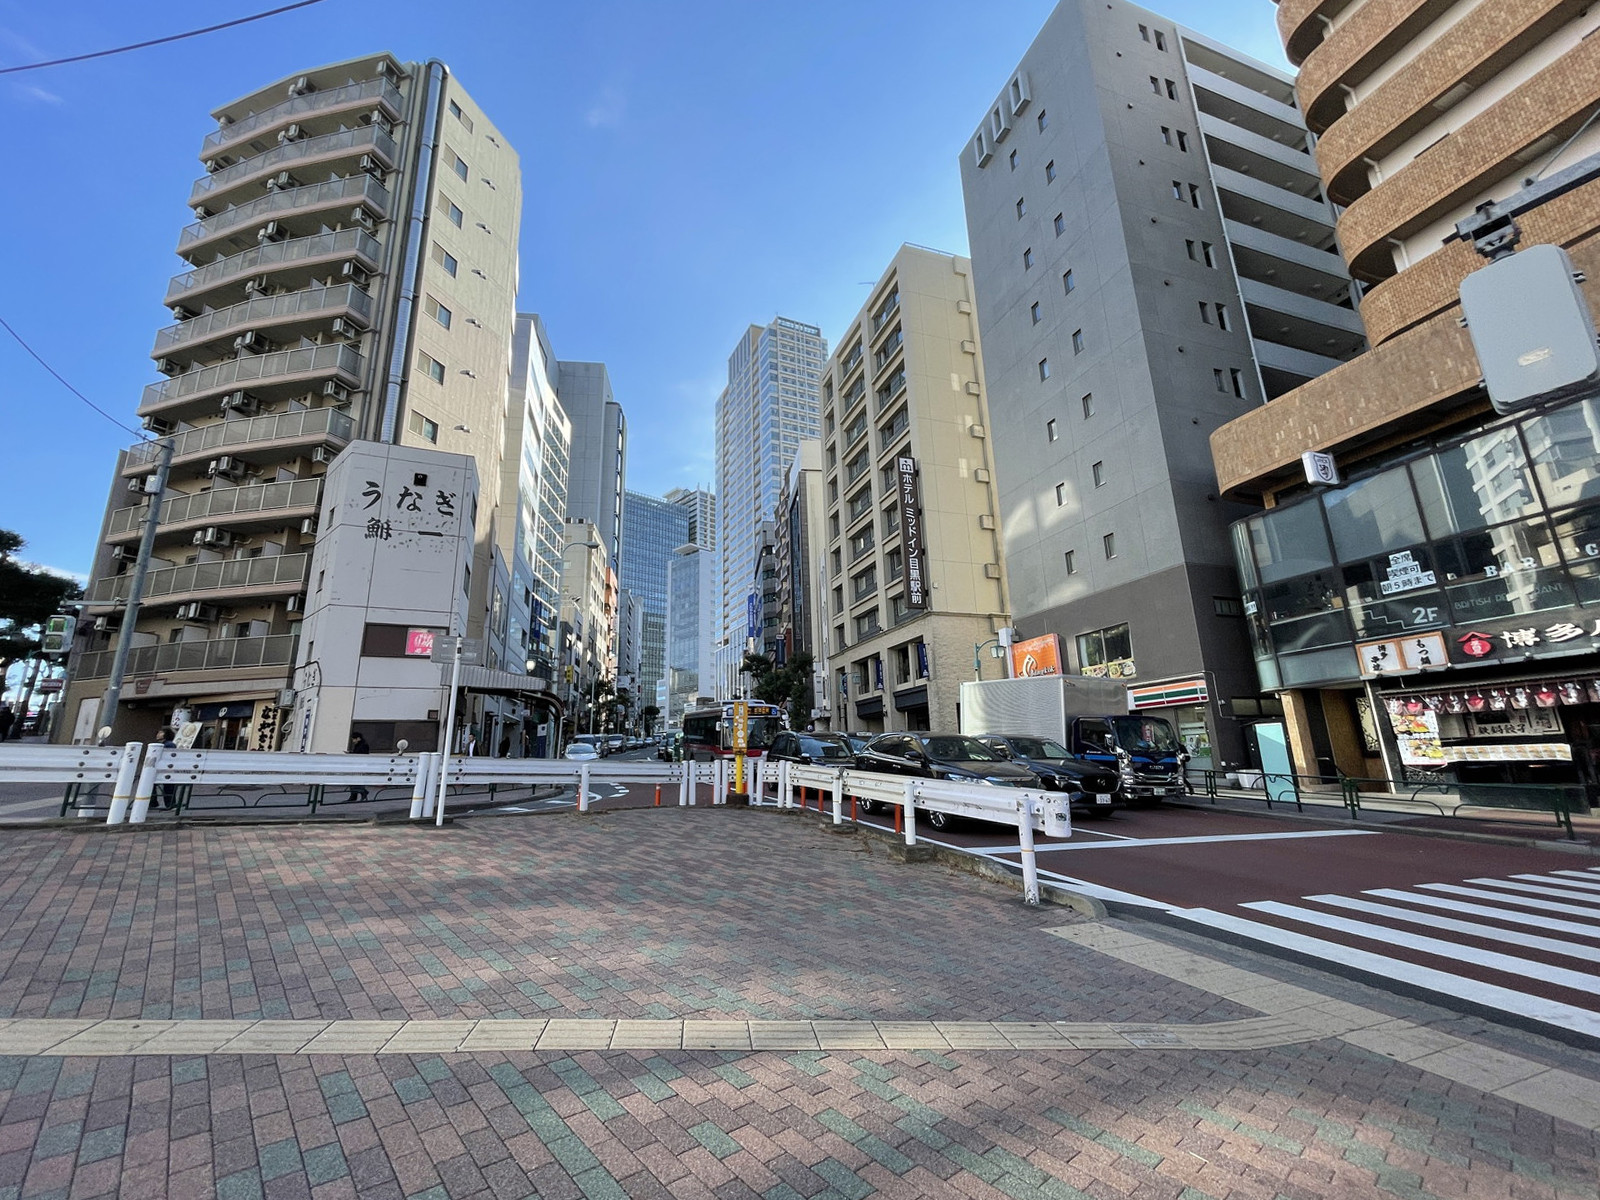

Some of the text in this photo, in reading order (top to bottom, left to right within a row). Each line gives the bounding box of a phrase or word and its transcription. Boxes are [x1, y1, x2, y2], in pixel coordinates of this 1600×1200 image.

[362, 480, 457, 517] うなぎ
[1390, 553, 1412, 565] 全席
[1483, 556, 1538, 578] BAR
[1387, 564, 1420, 579] 喫煙可
[1411, 606, 1439, 624] 2F
[1416, 639, 1432, 665] もつ鍋
